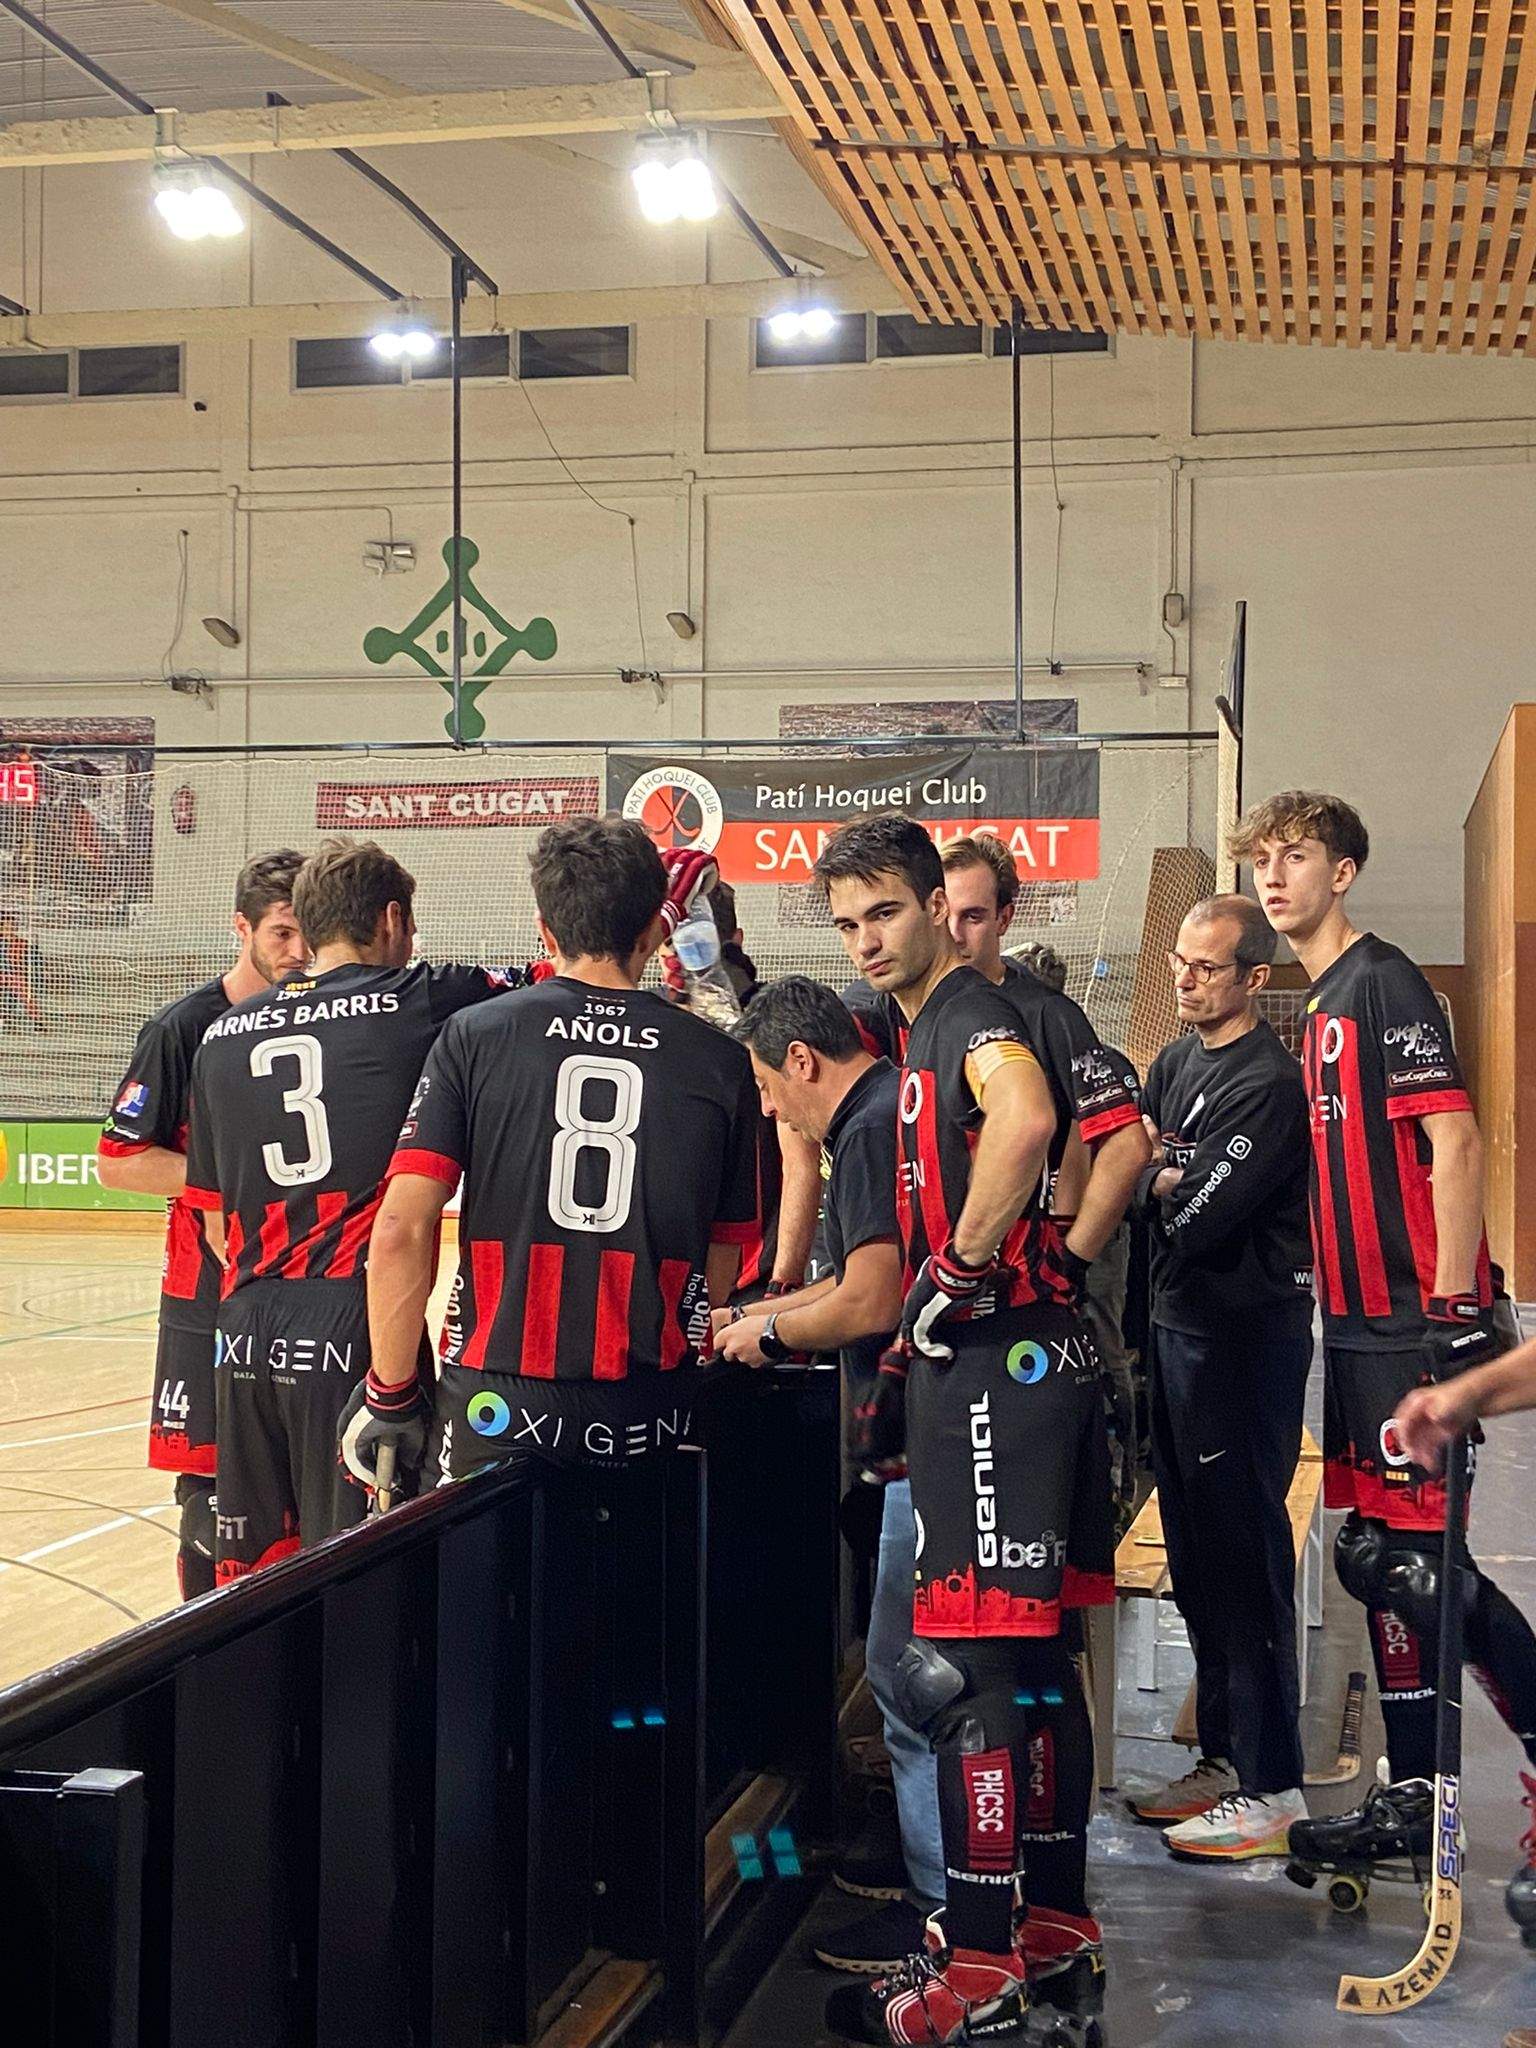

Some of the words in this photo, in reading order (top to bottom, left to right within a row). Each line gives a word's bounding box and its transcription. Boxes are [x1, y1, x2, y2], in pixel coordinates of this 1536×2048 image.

[344, 794, 438, 818] SANT
[449, 790, 570, 816] CUGAT
[644, 771, 696, 791] HOQUEI
[696, 784, 718, 814] CLUB
[755, 783, 804, 809] Patí
[815, 781, 912, 811] Hoquei
[922, 777, 987, 805] Club
[201, 1006, 288, 1046] FARNÉS
[293, 992, 400, 1025] BARRIS
[584, 1003, 627, 1017] 1967
[545, 1015, 660, 1050] AÑOLS
[250, 1034, 333, 1187] 3
[547, 1054, 644, 1233] 8
[159, 1379, 191, 1419] 44
[971, 1769, 1005, 1833] PHCSC
